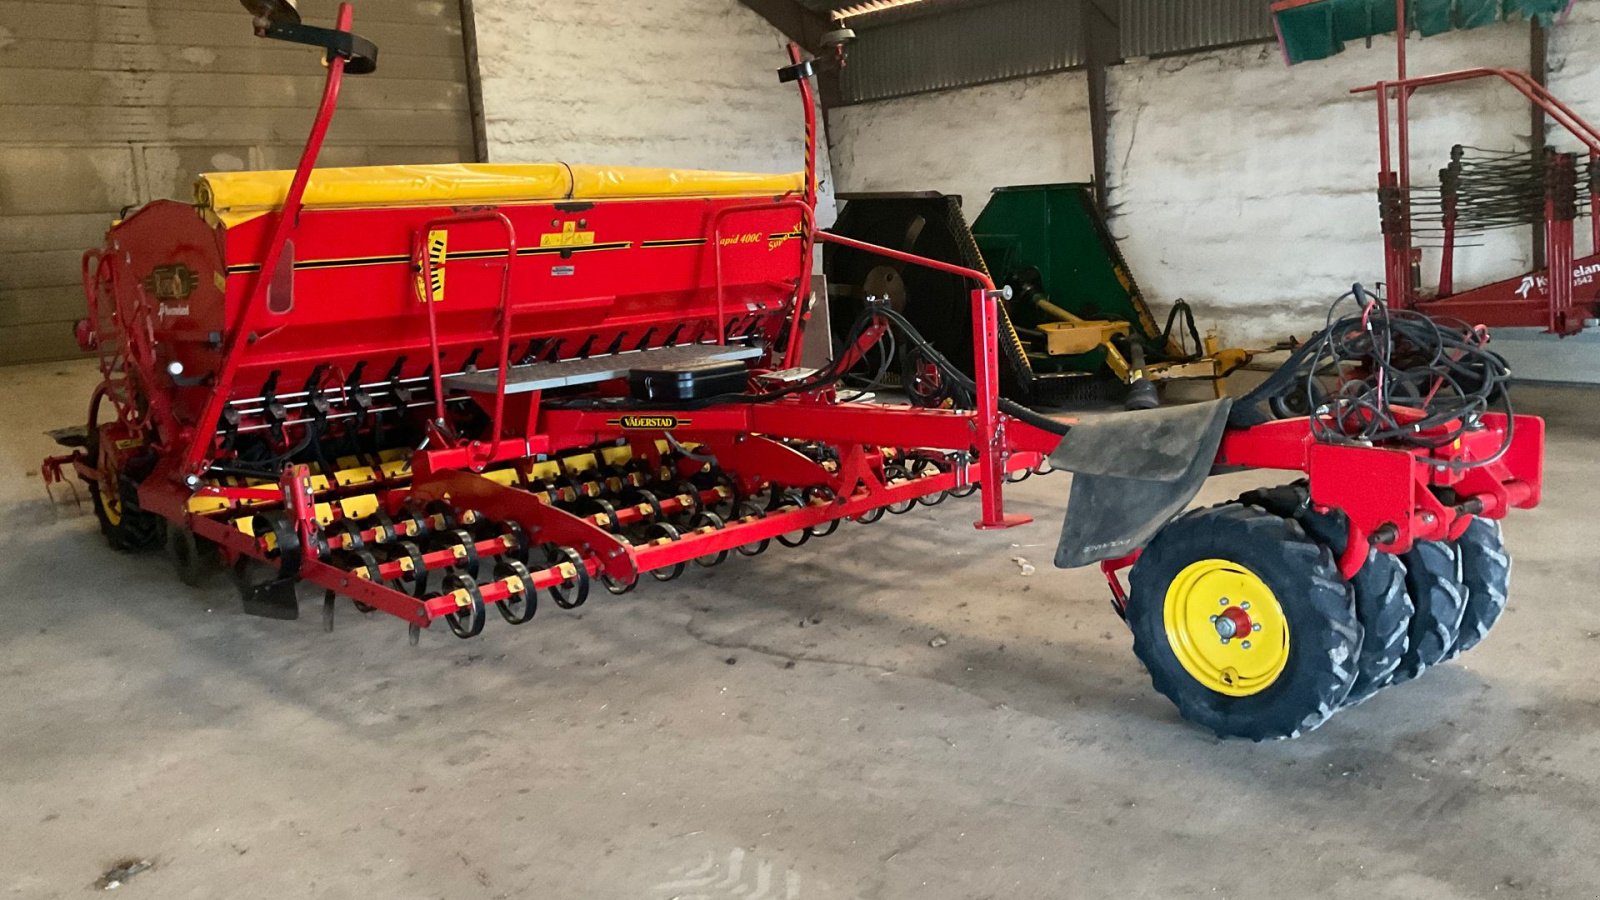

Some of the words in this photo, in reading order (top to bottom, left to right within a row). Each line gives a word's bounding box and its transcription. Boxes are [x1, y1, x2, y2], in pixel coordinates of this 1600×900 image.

[713, 233, 739, 246] apid
[740, 232, 762, 244] 400C
[624, 416, 673, 427] VÄDERSTAD
